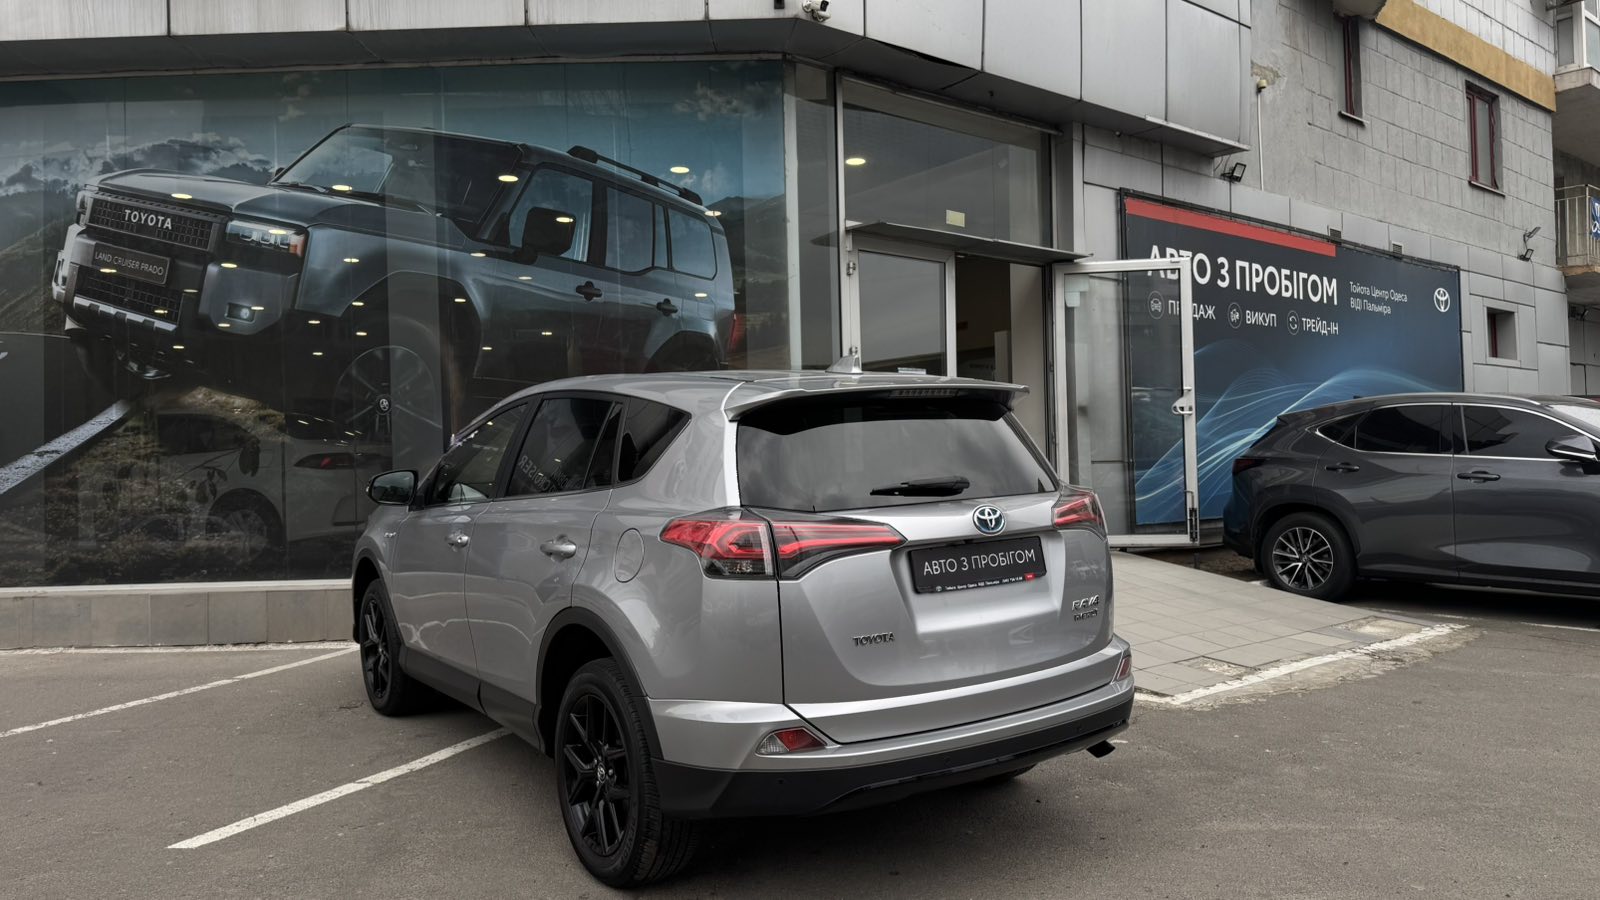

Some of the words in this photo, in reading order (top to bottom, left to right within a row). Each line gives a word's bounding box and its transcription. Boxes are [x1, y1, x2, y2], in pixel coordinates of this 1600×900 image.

[124, 209, 172, 230] TOYOTA
[94, 251, 112, 263] LAND
[113, 256, 140, 269] CRUISER
[140, 262, 164, 276] PRADO
[1147, 245, 1211, 284] АВО
[1235, 260, 1338, 305] ПРОБІГОМ
[1349, 281, 1370, 296] Тойота
[1371, 286, 1389, 301] Центр
[1390, 289, 1408, 303] Одеса
[1168, 299, 1216, 320] ПДАЖ
[1363, 299, 1392, 316] Пальміра
[1245, 310, 1277, 328] ВИКУП
[1301, 317, 1339, 336] ТРЕЙД-ІН
[923, 558, 958, 576] АВТО
[971, 549, 1036, 569] ПРОБІГОМ
[852, 631, 896, 647] TOYOTA
